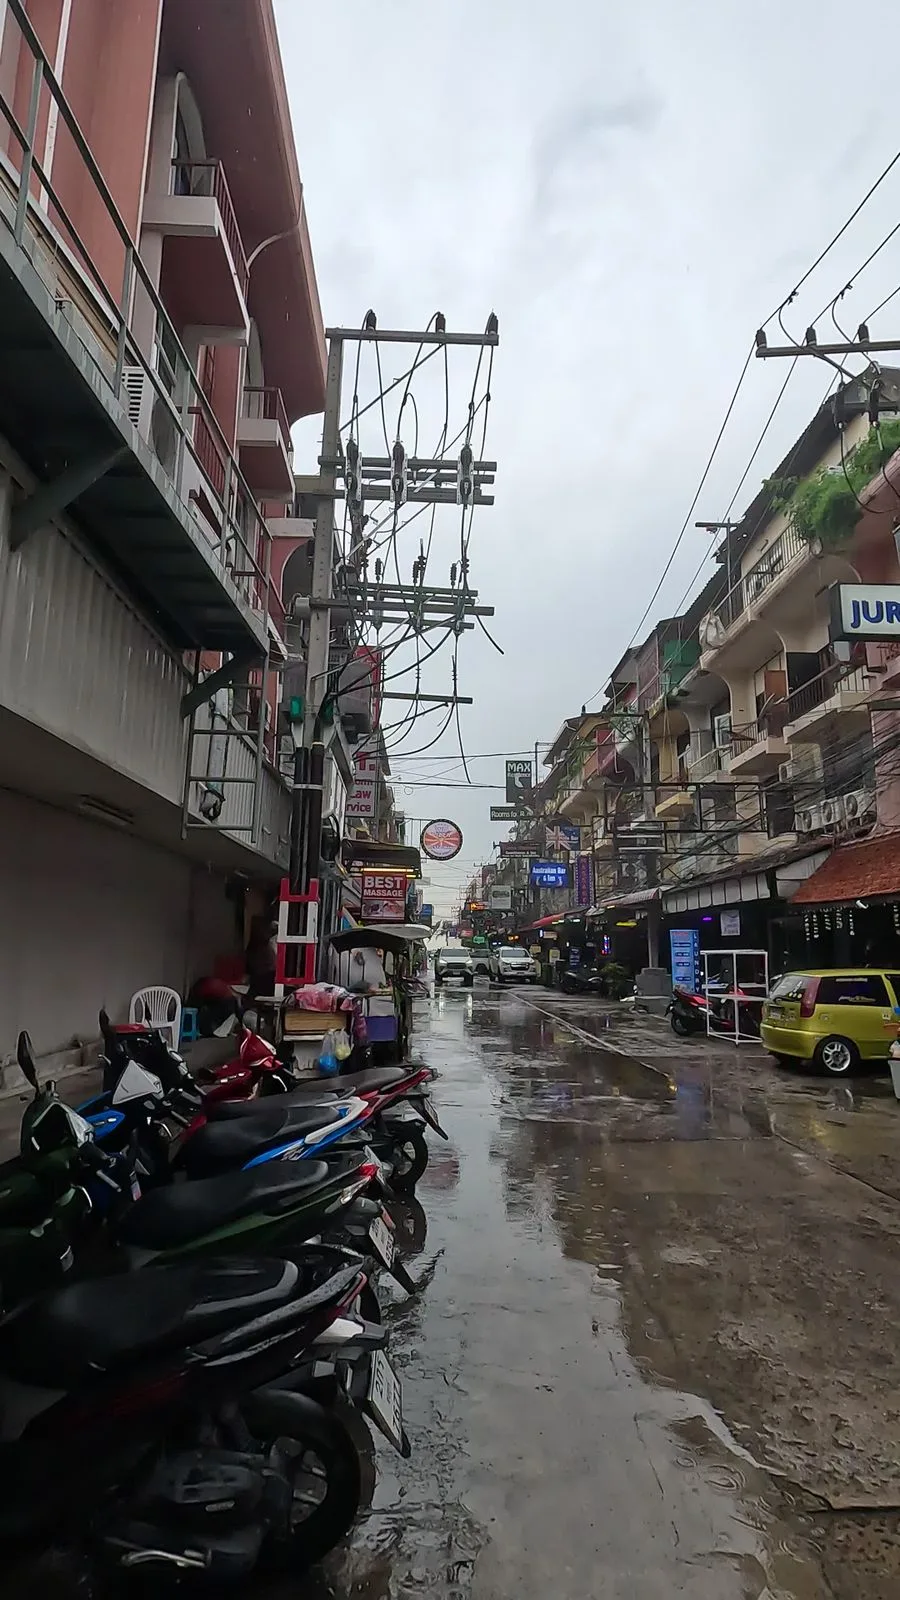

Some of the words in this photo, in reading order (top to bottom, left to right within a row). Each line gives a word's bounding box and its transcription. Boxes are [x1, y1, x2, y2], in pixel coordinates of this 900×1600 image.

[507, 762, 531, 772] MAX
[532, 866, 556, 874] Australian
[557, 866, 566, 874] Bar
[364, 876, 404, 889] BEST
[363, 889, 404, 897] MASSAGE
